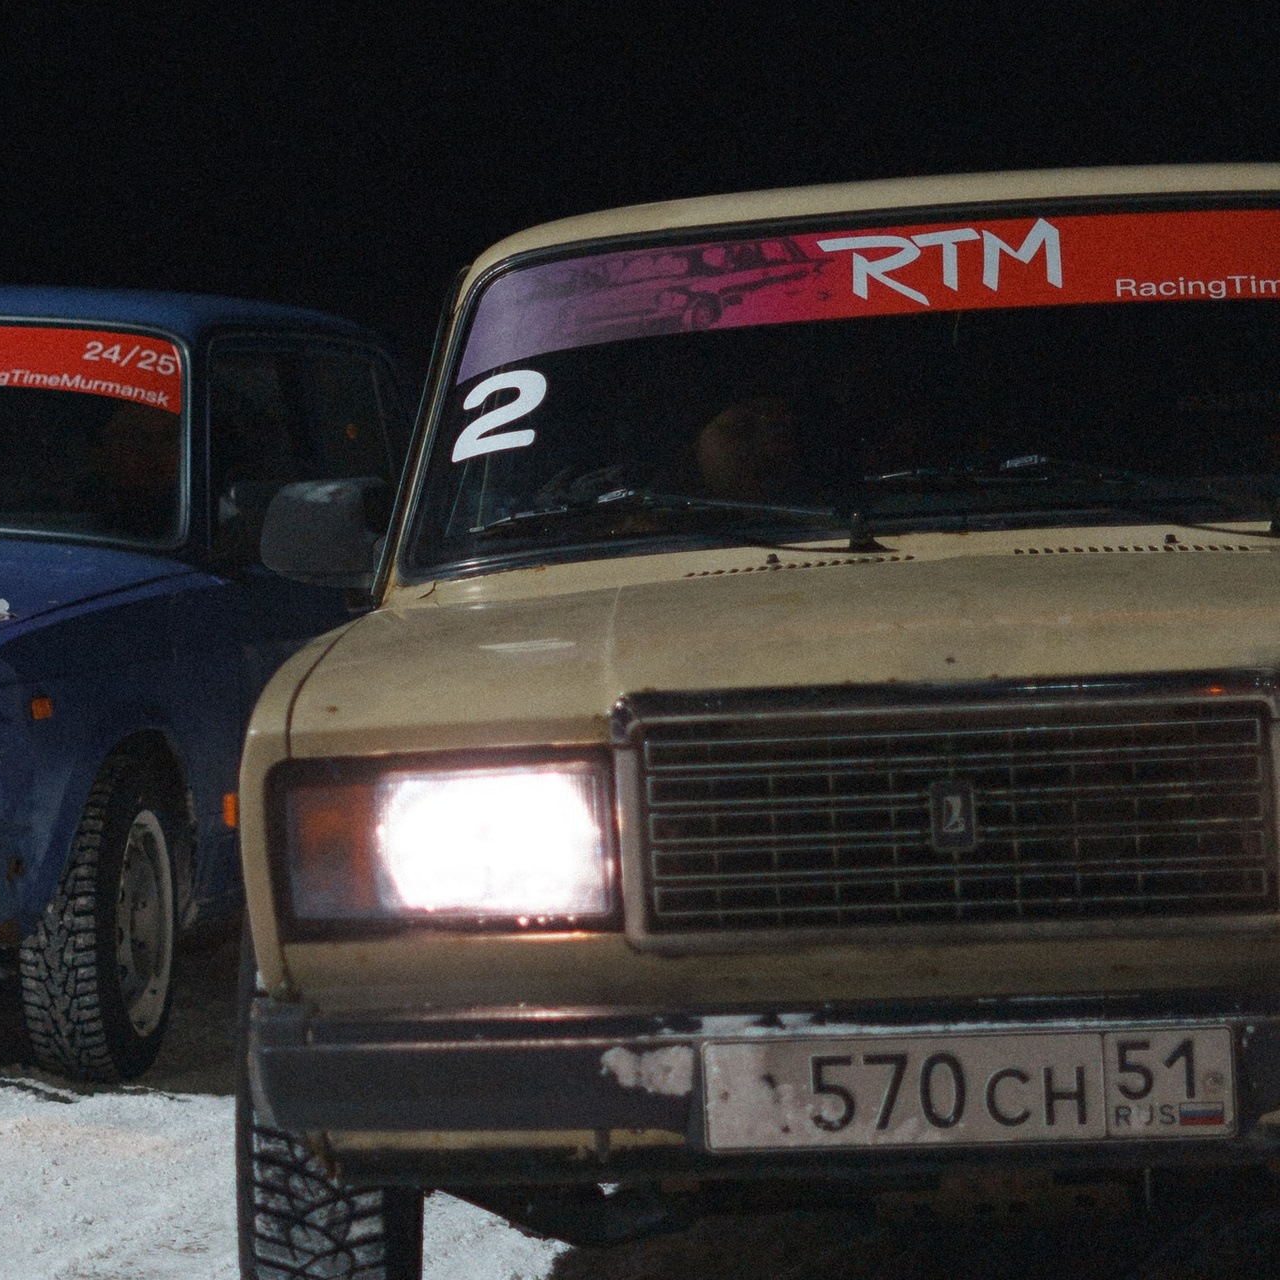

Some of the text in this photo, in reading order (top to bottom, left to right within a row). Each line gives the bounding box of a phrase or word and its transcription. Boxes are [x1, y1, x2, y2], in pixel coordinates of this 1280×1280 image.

[816, 218, 1063, 306] RTM
[82, 341, 177, 375] 24/25
[451, 369, 548, 463] 2
[1117, 1038, 1196, 1100] 51
